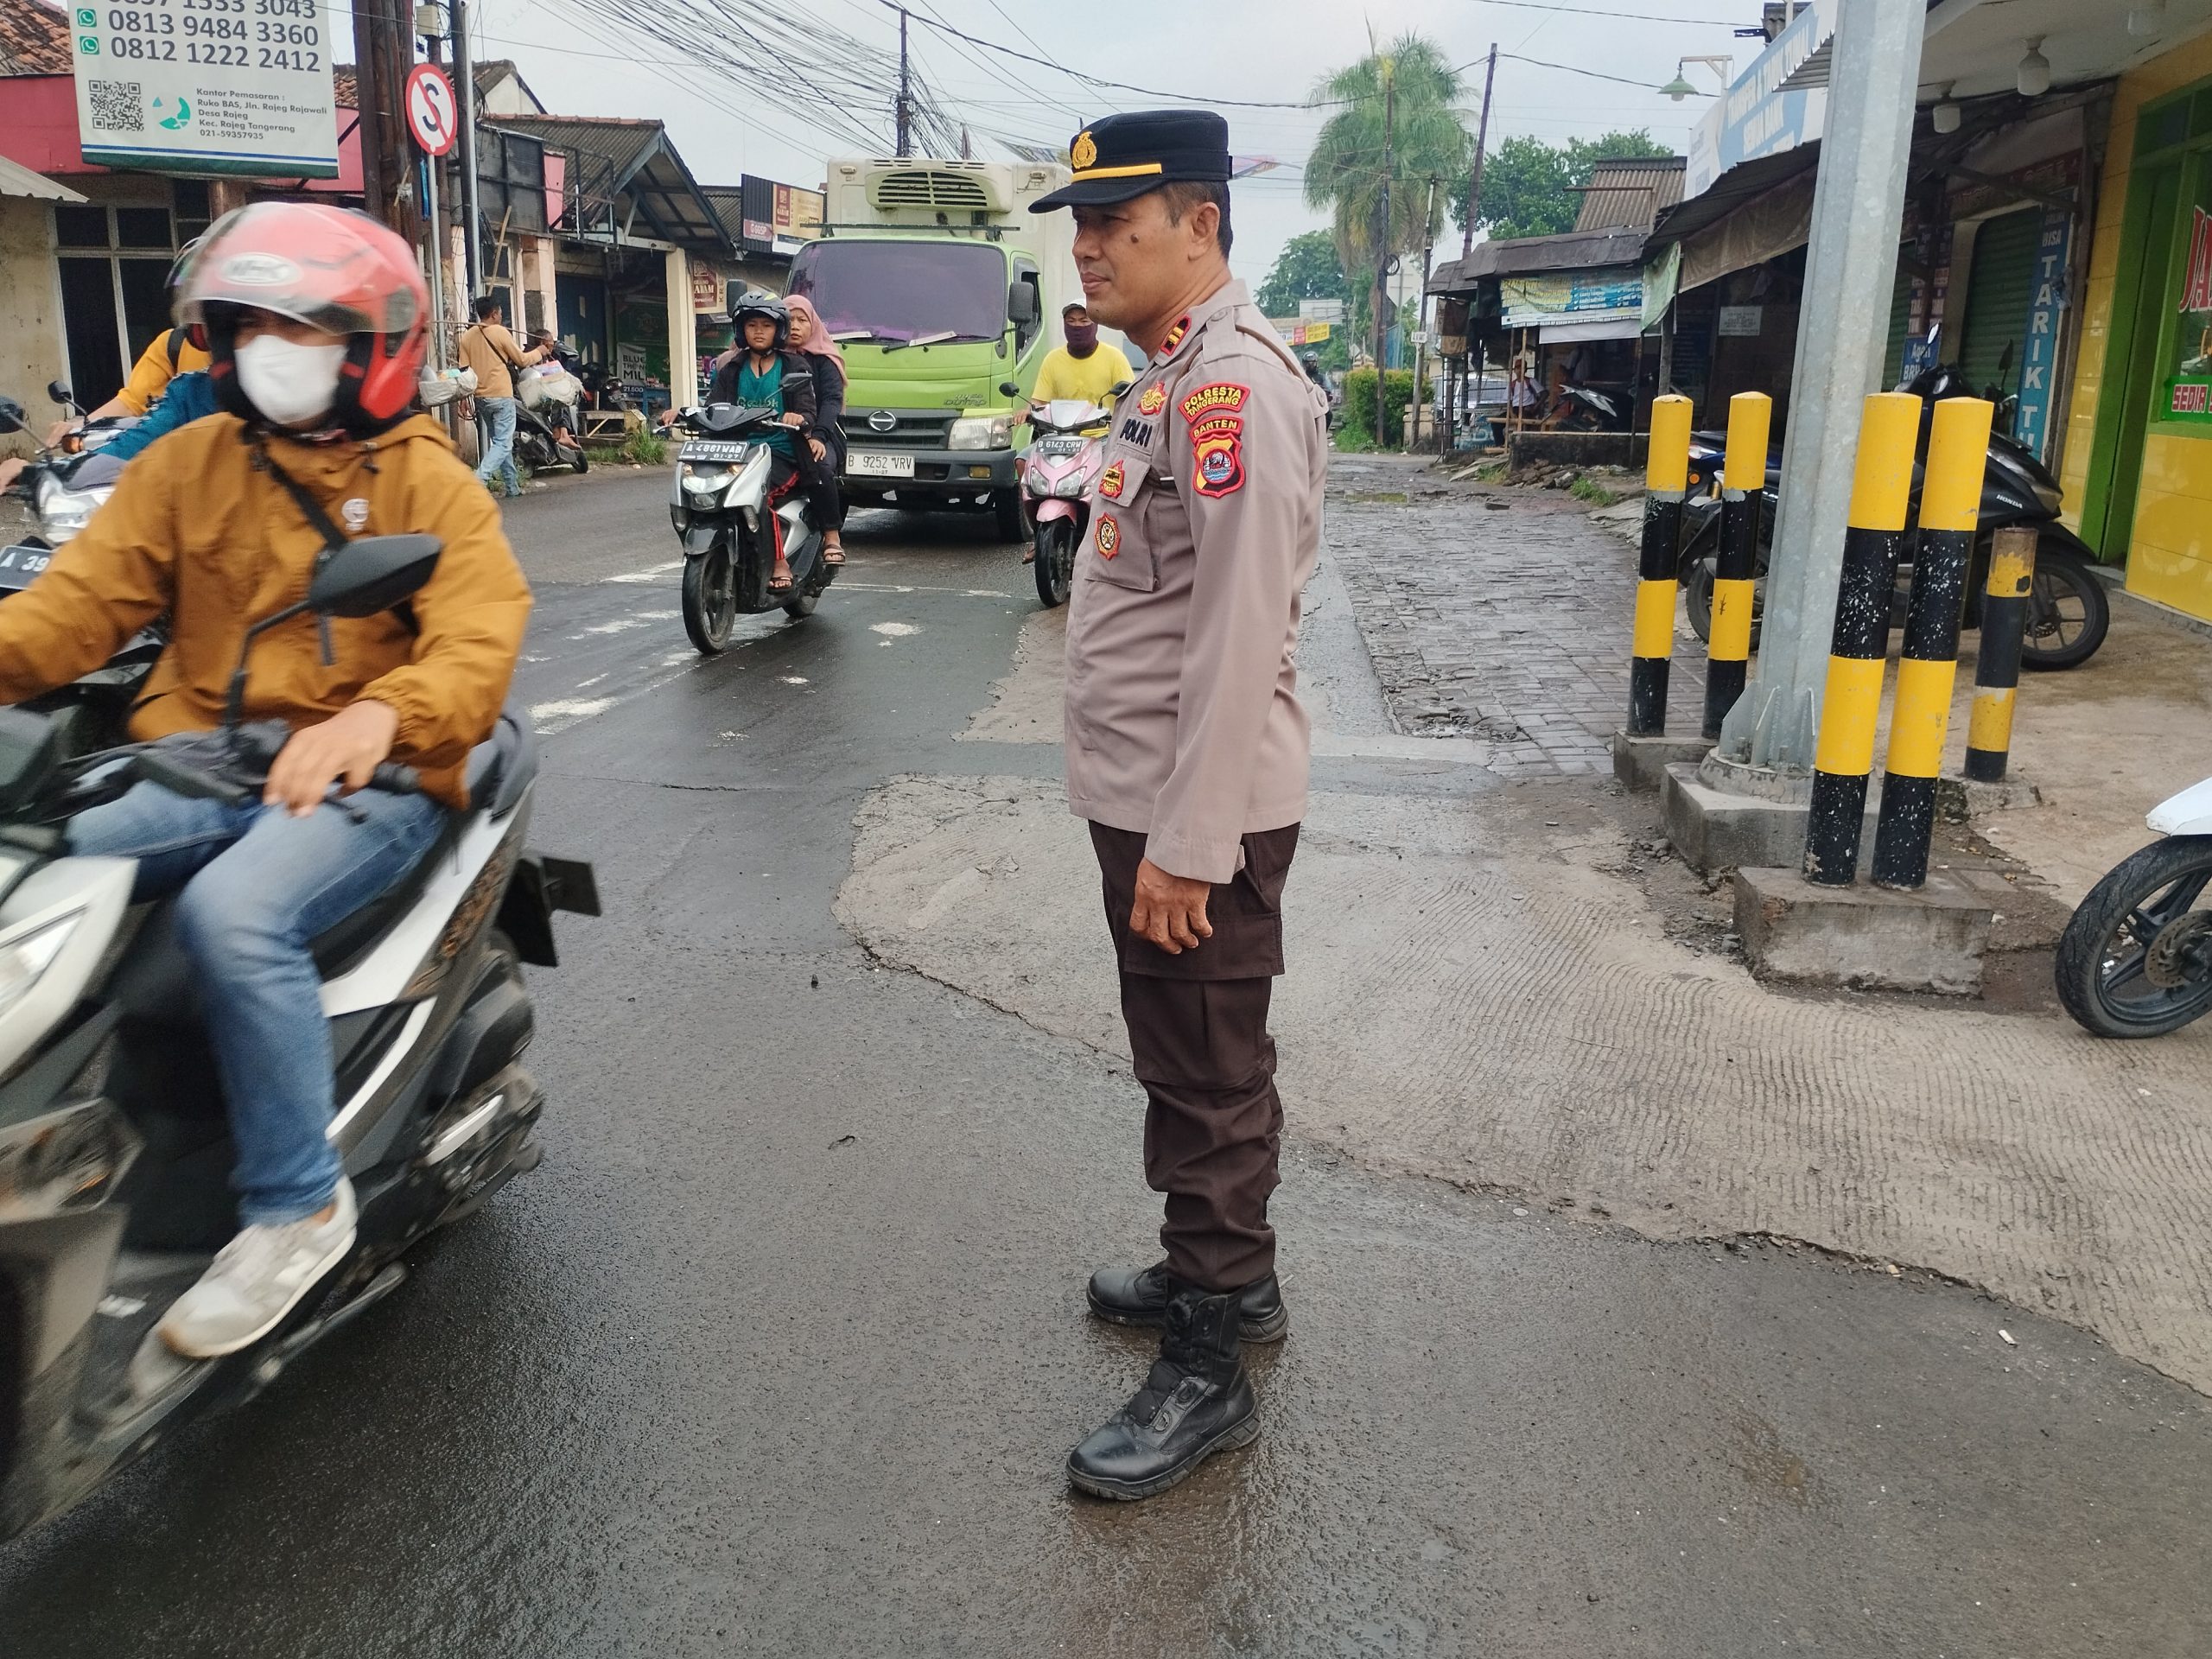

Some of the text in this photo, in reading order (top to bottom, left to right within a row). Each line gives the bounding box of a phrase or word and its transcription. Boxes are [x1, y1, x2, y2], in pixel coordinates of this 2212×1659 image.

[255, 0, 316, 19] 3043
[108, 10, 319, 47] 0813 9484 3360
[111, 36, 321, 73] 0812 1222 2412
[196, 88, 227, 97] Kantor
[229, 91, 280, 100] Pemasaran
[197, 99, 219, 107] Ruko
[222, 100, 242, 109] BAS,
[263, 103, 288, 113] Rajeg
[289, 105, 327, 115] Rajawali
[198, 109, 248, 120] Desa Rajeg
[199, 119, 296, 133] Kec. Rajeg Tangerang
[200, 129, 264, 140] 021-59357935
[2042, 230, 2062, 247] BISA
[2024, 255, 2057, 390] TARIK
[1184, 386, 1242, 411] POLRESTA
[1186, 396, 1239, 416] TANGERANG
[2171, 384, 2209, 412] SEDIA
[1120, 418, 1153, 448] POLRI
[1193, 419, 1237, 437] BANTEN
[848, 454, 912, 470] B 9252 VRV
[1996, 493, 2023, 509] HONDA
[0, 552, 16, 568] A
